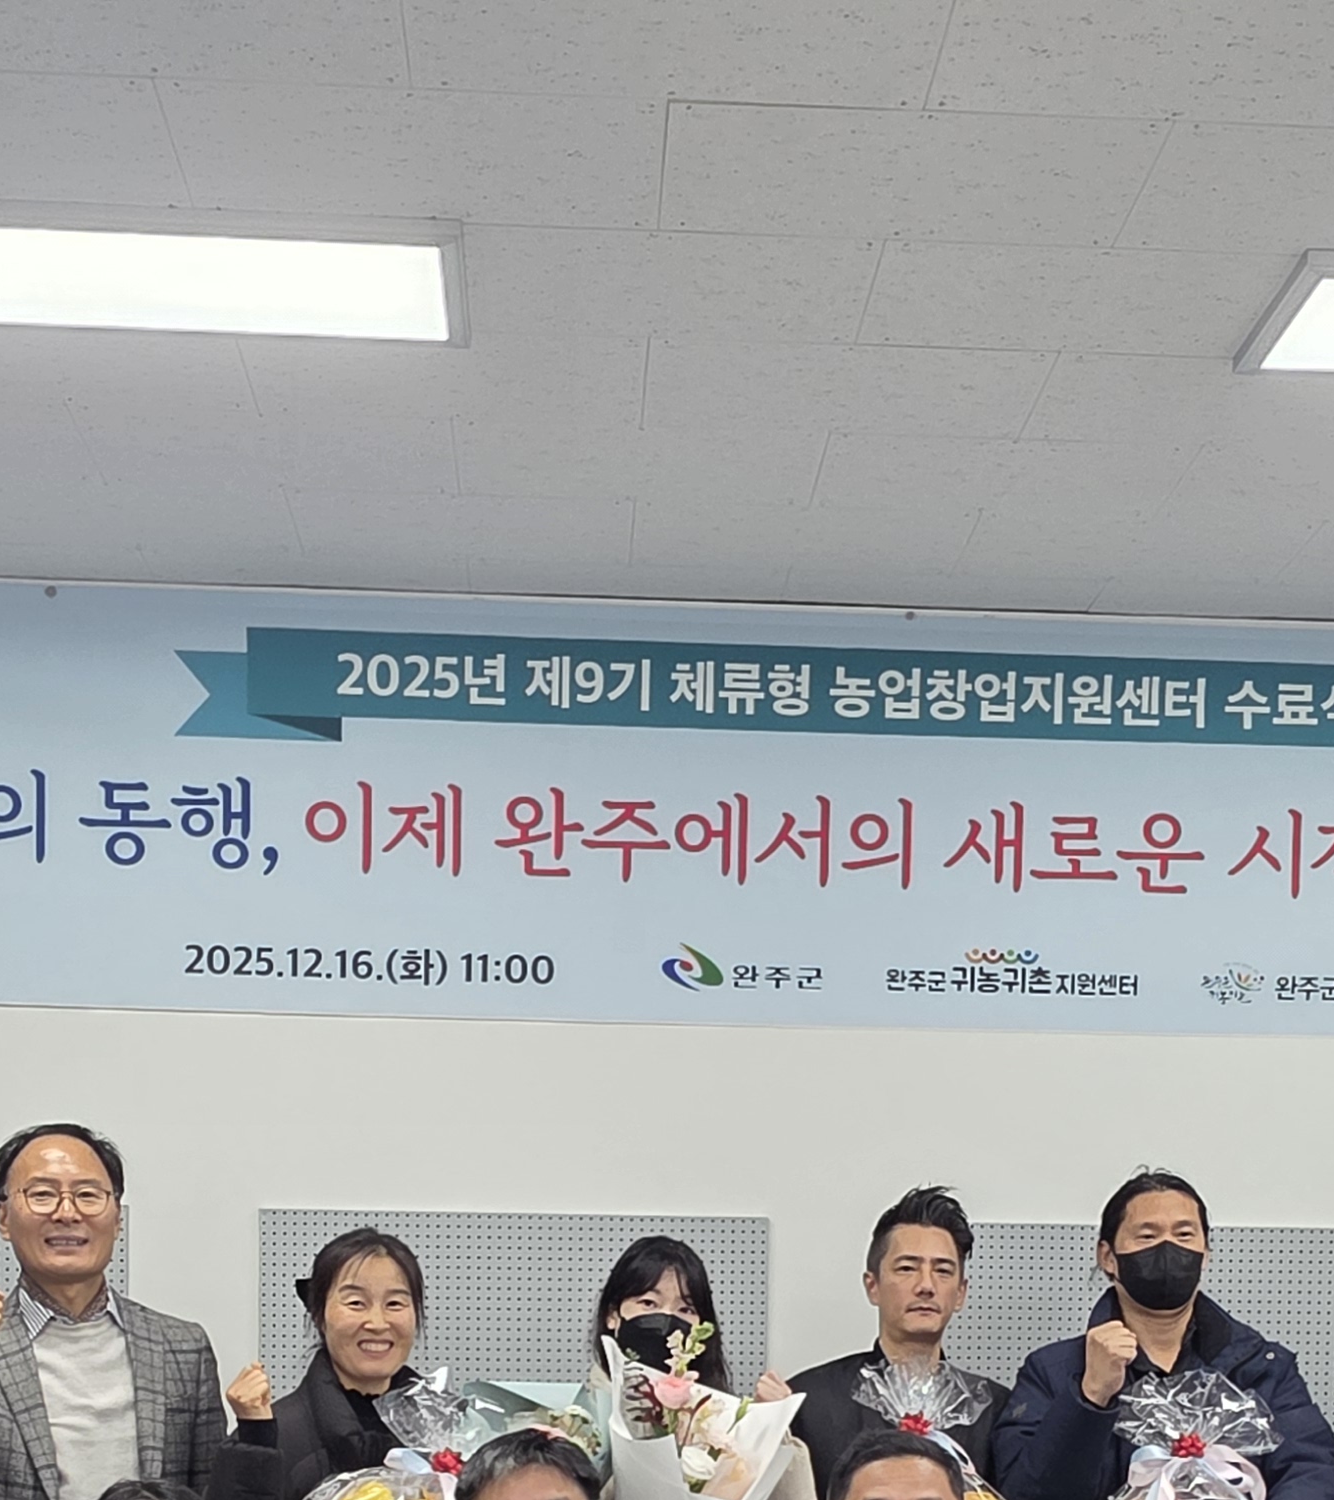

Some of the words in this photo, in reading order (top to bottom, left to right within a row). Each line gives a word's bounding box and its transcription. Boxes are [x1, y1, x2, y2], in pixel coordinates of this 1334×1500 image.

[336, 653, 507, 706] 2025년
[525, 656, 651, 712] 제9기
[670, 660, 811, 716] 체류형
[828, 665, 1208, 730] 농업창업지원센터
[78, 776, 280, 876] 동행,
[304, 780, 464, 877] 이제
[493, 787, 914, 890] 완주에서의
[943, 801, 1205, 894] 새로운
[184, 944, 449, 987] 2025.12.16.(화)
[460, 953, 556, 986] 11:00
[731, 965, 823, 992] 완주군
[885, 968, 947, 994] 완주군
